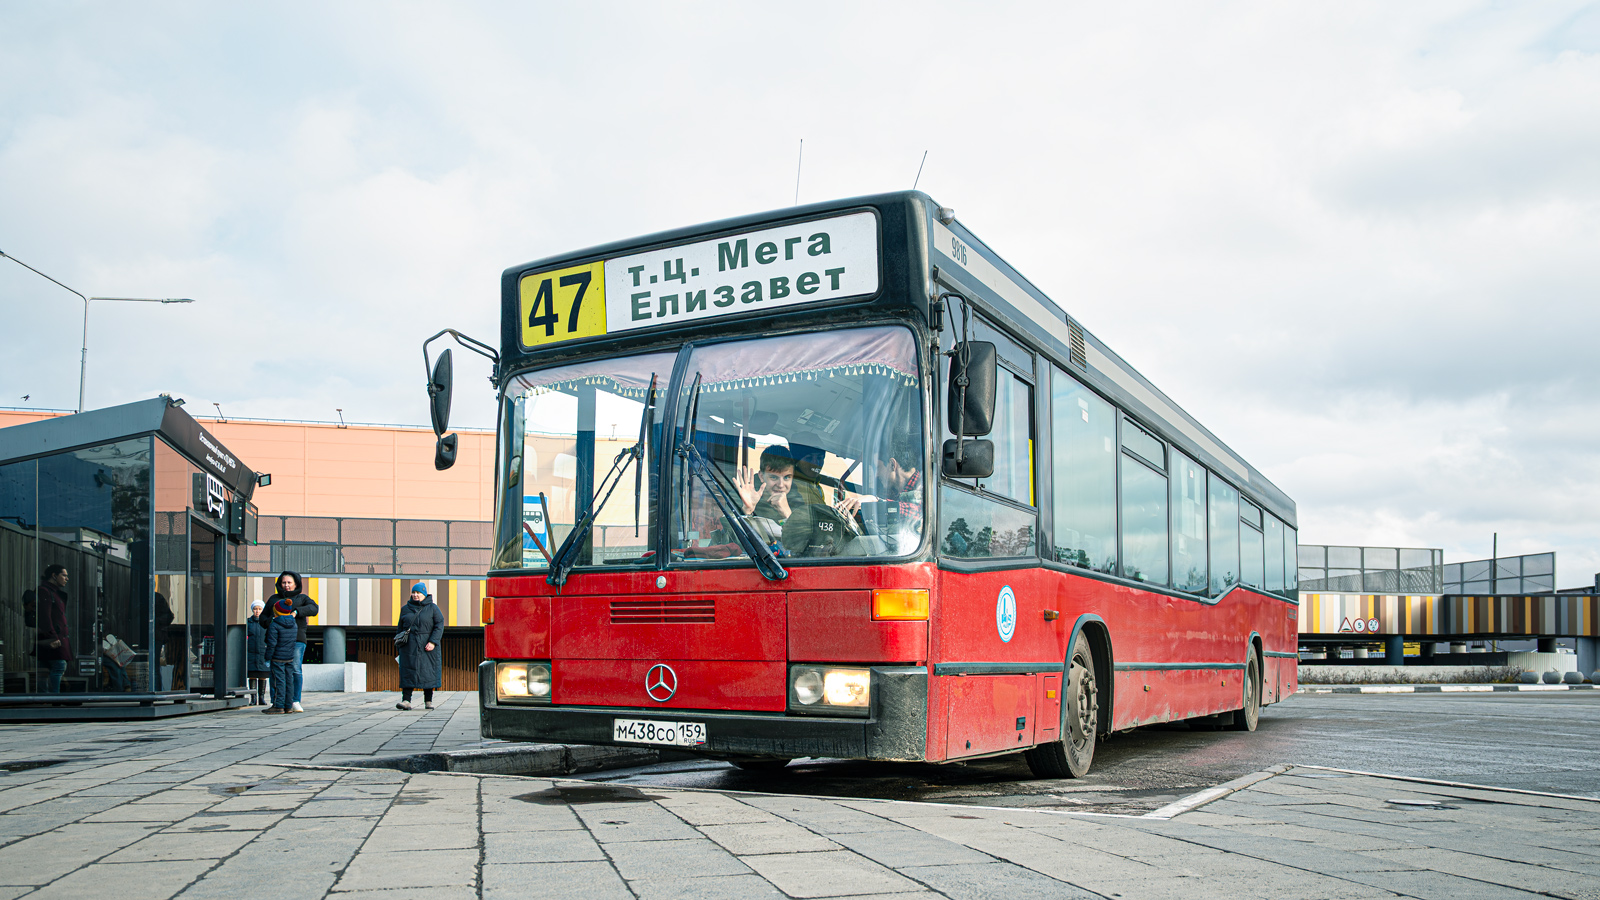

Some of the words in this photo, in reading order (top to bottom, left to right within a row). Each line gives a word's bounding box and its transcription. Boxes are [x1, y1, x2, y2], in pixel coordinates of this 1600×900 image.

[628, 258, 700, 288] т.ц.
[718, 231, 832, 272] Мега
[952, 237, 967, 266] 9816
[528, 271, 592, 337] 47
[631, 267, 846, 321] Елизавет
[818, 521, 834, 532] 438
[679, 724, 702, 738] 159
